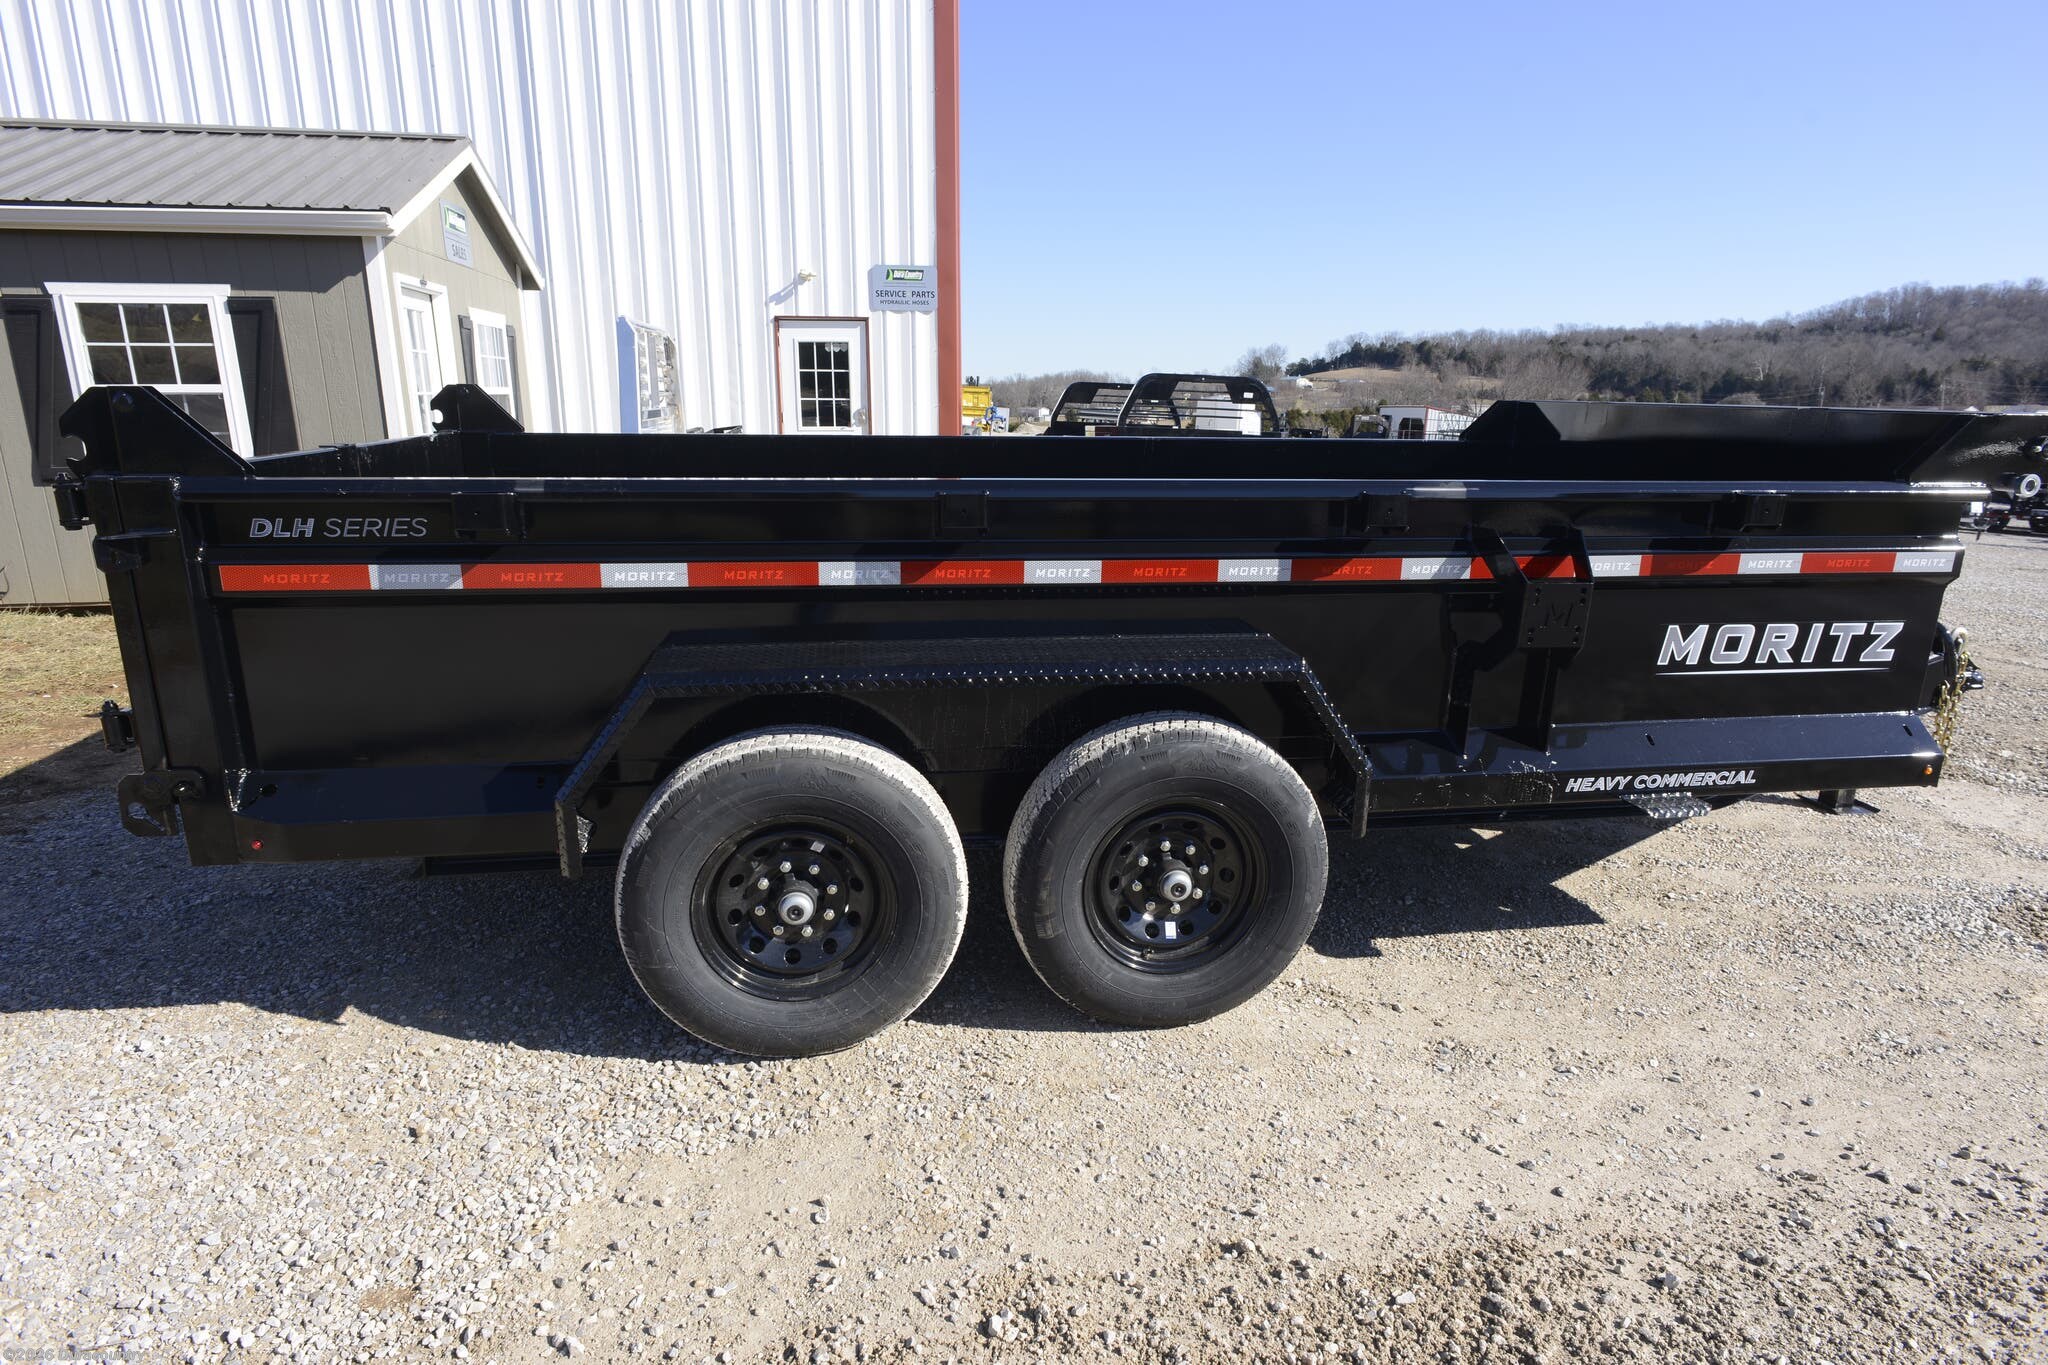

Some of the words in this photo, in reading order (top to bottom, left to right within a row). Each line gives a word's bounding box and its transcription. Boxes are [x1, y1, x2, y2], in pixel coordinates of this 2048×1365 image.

[451, 243, 467, 260] SALES
[875, 289, 907, 298] SERVICE
[911, 290, 935, 298] PARTS
[249, 518, 315, 537] DLH
[323, 518, 428, 538] SERIES
[1591, 562, 1632, 571] ORITZ
[1747, 559, 1796, 569] MORITZ
[1826, 558, 1872, 568] MORITZ
[1902, 558, 1947, 567] MORITZ
[830, 569, 889, 579] MORITZ
[935, 568, 992, 578] MORITZ
[1035, 568, 1091, 578] MORITZ
[1132, 567, 1187, 577] MORITZ
[1228, 566, 1279, 576] MORITZ
[1411, 564, 1461, 574] MORITZ
[262, 573, 331, 584] MORITZ
[384, 573, 449, 583] MORITZ
[500, 572, 564, 582] MORITZ
[613, 571, 677, 581] MORITZ
[724, 570, 784, 580] MORITZ
[1656, 622, 1905, 665] MORITZ
[1565, 775, 1632, 793] HEAVY
[1633, 770, 1757, 789] COMMERCIAL
